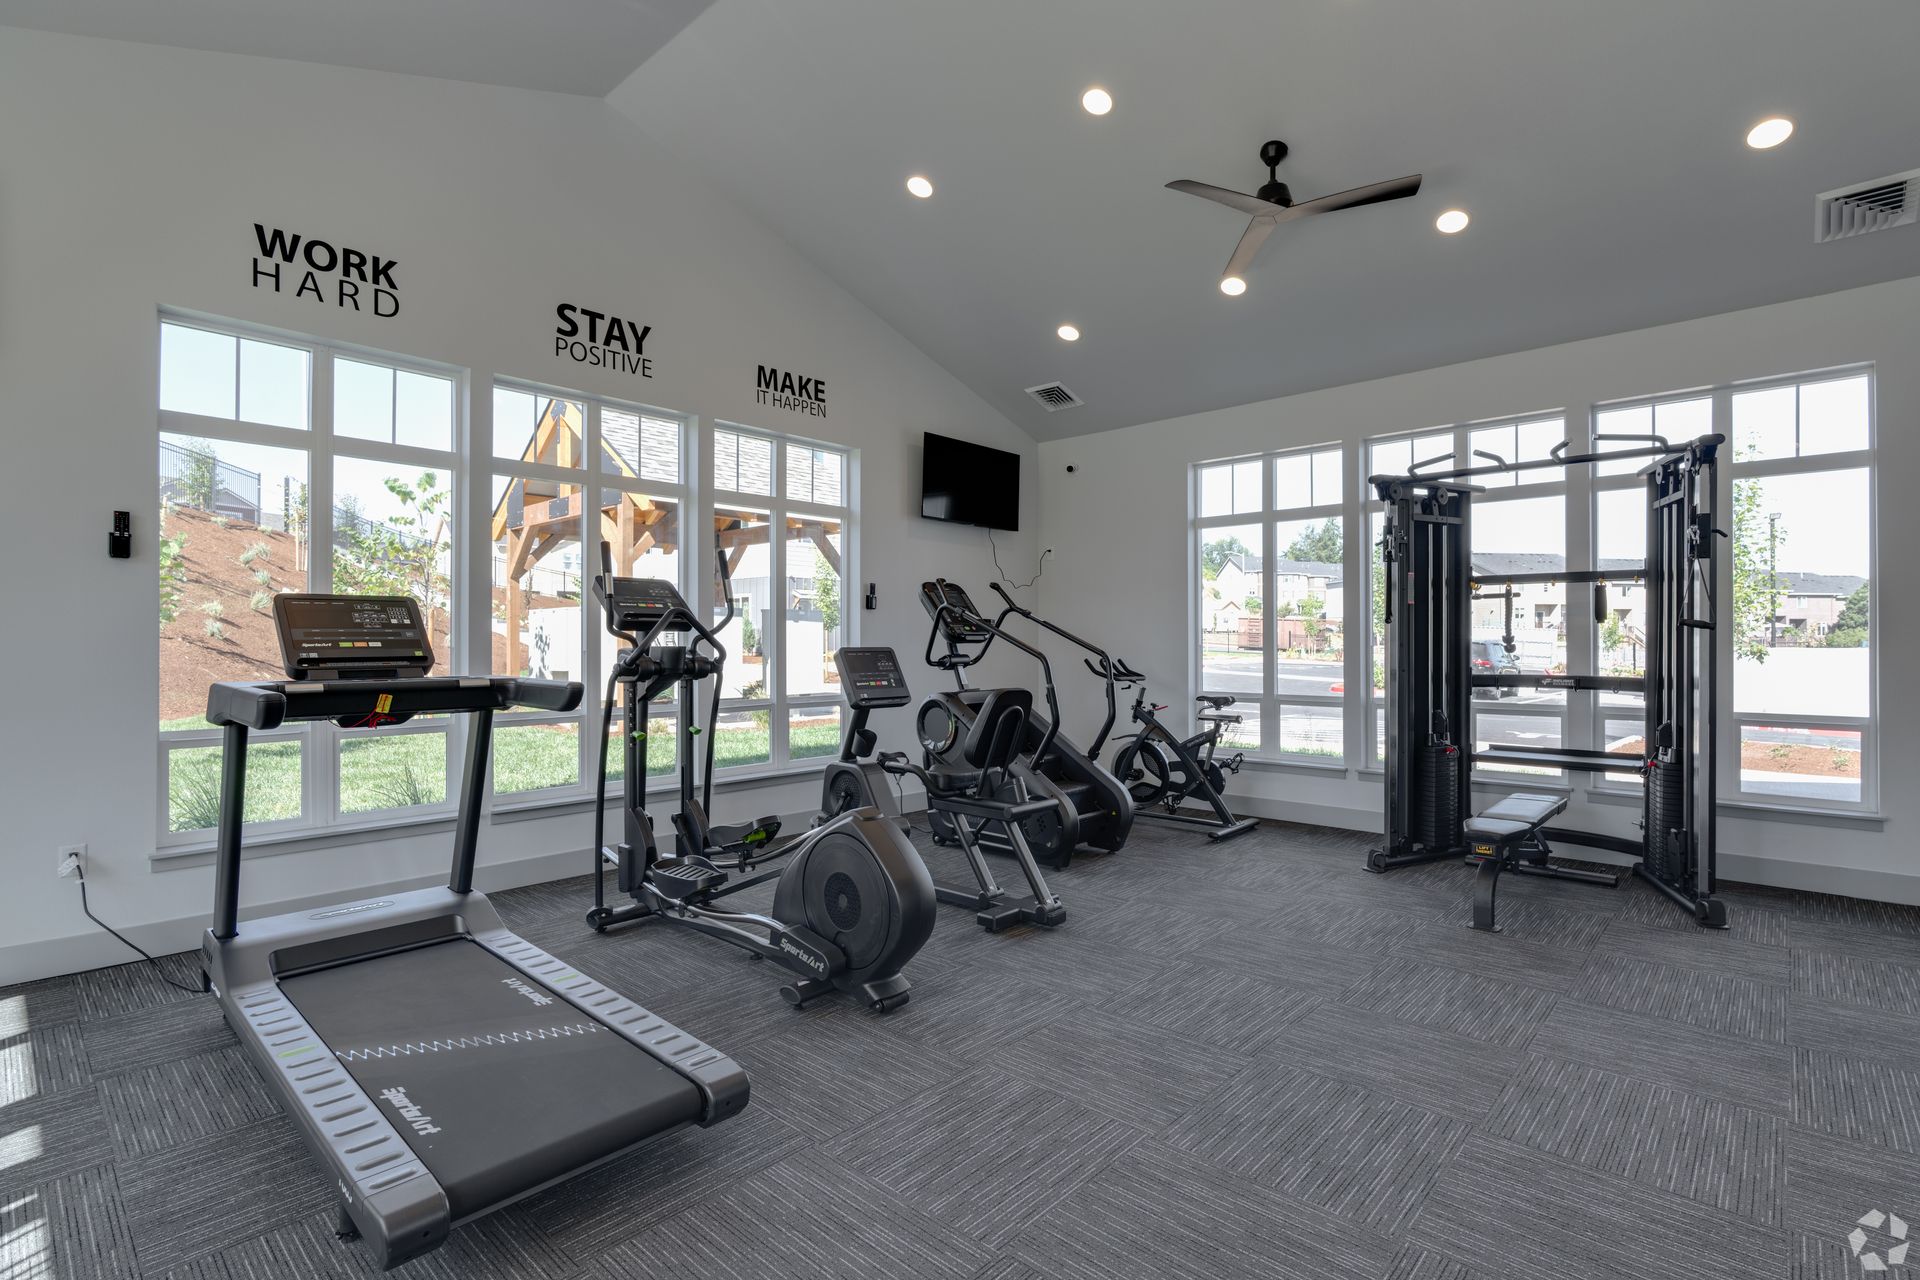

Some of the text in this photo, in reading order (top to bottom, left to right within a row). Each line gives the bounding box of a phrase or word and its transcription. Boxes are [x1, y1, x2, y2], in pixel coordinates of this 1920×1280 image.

[254, 223, 399, 290] WORK
[252, 257, 399, 318] HARD
[556, 303, 652, 355] STAY
[556, 336, 653, 379] POSITIVE
[757, 364, 826, 403] MAKE
[757, 389, 827, 418] IT HAPPEN
[780, 937, 825, 972] SportsArt
[379, 1086, 442, 1136] SportsArt
